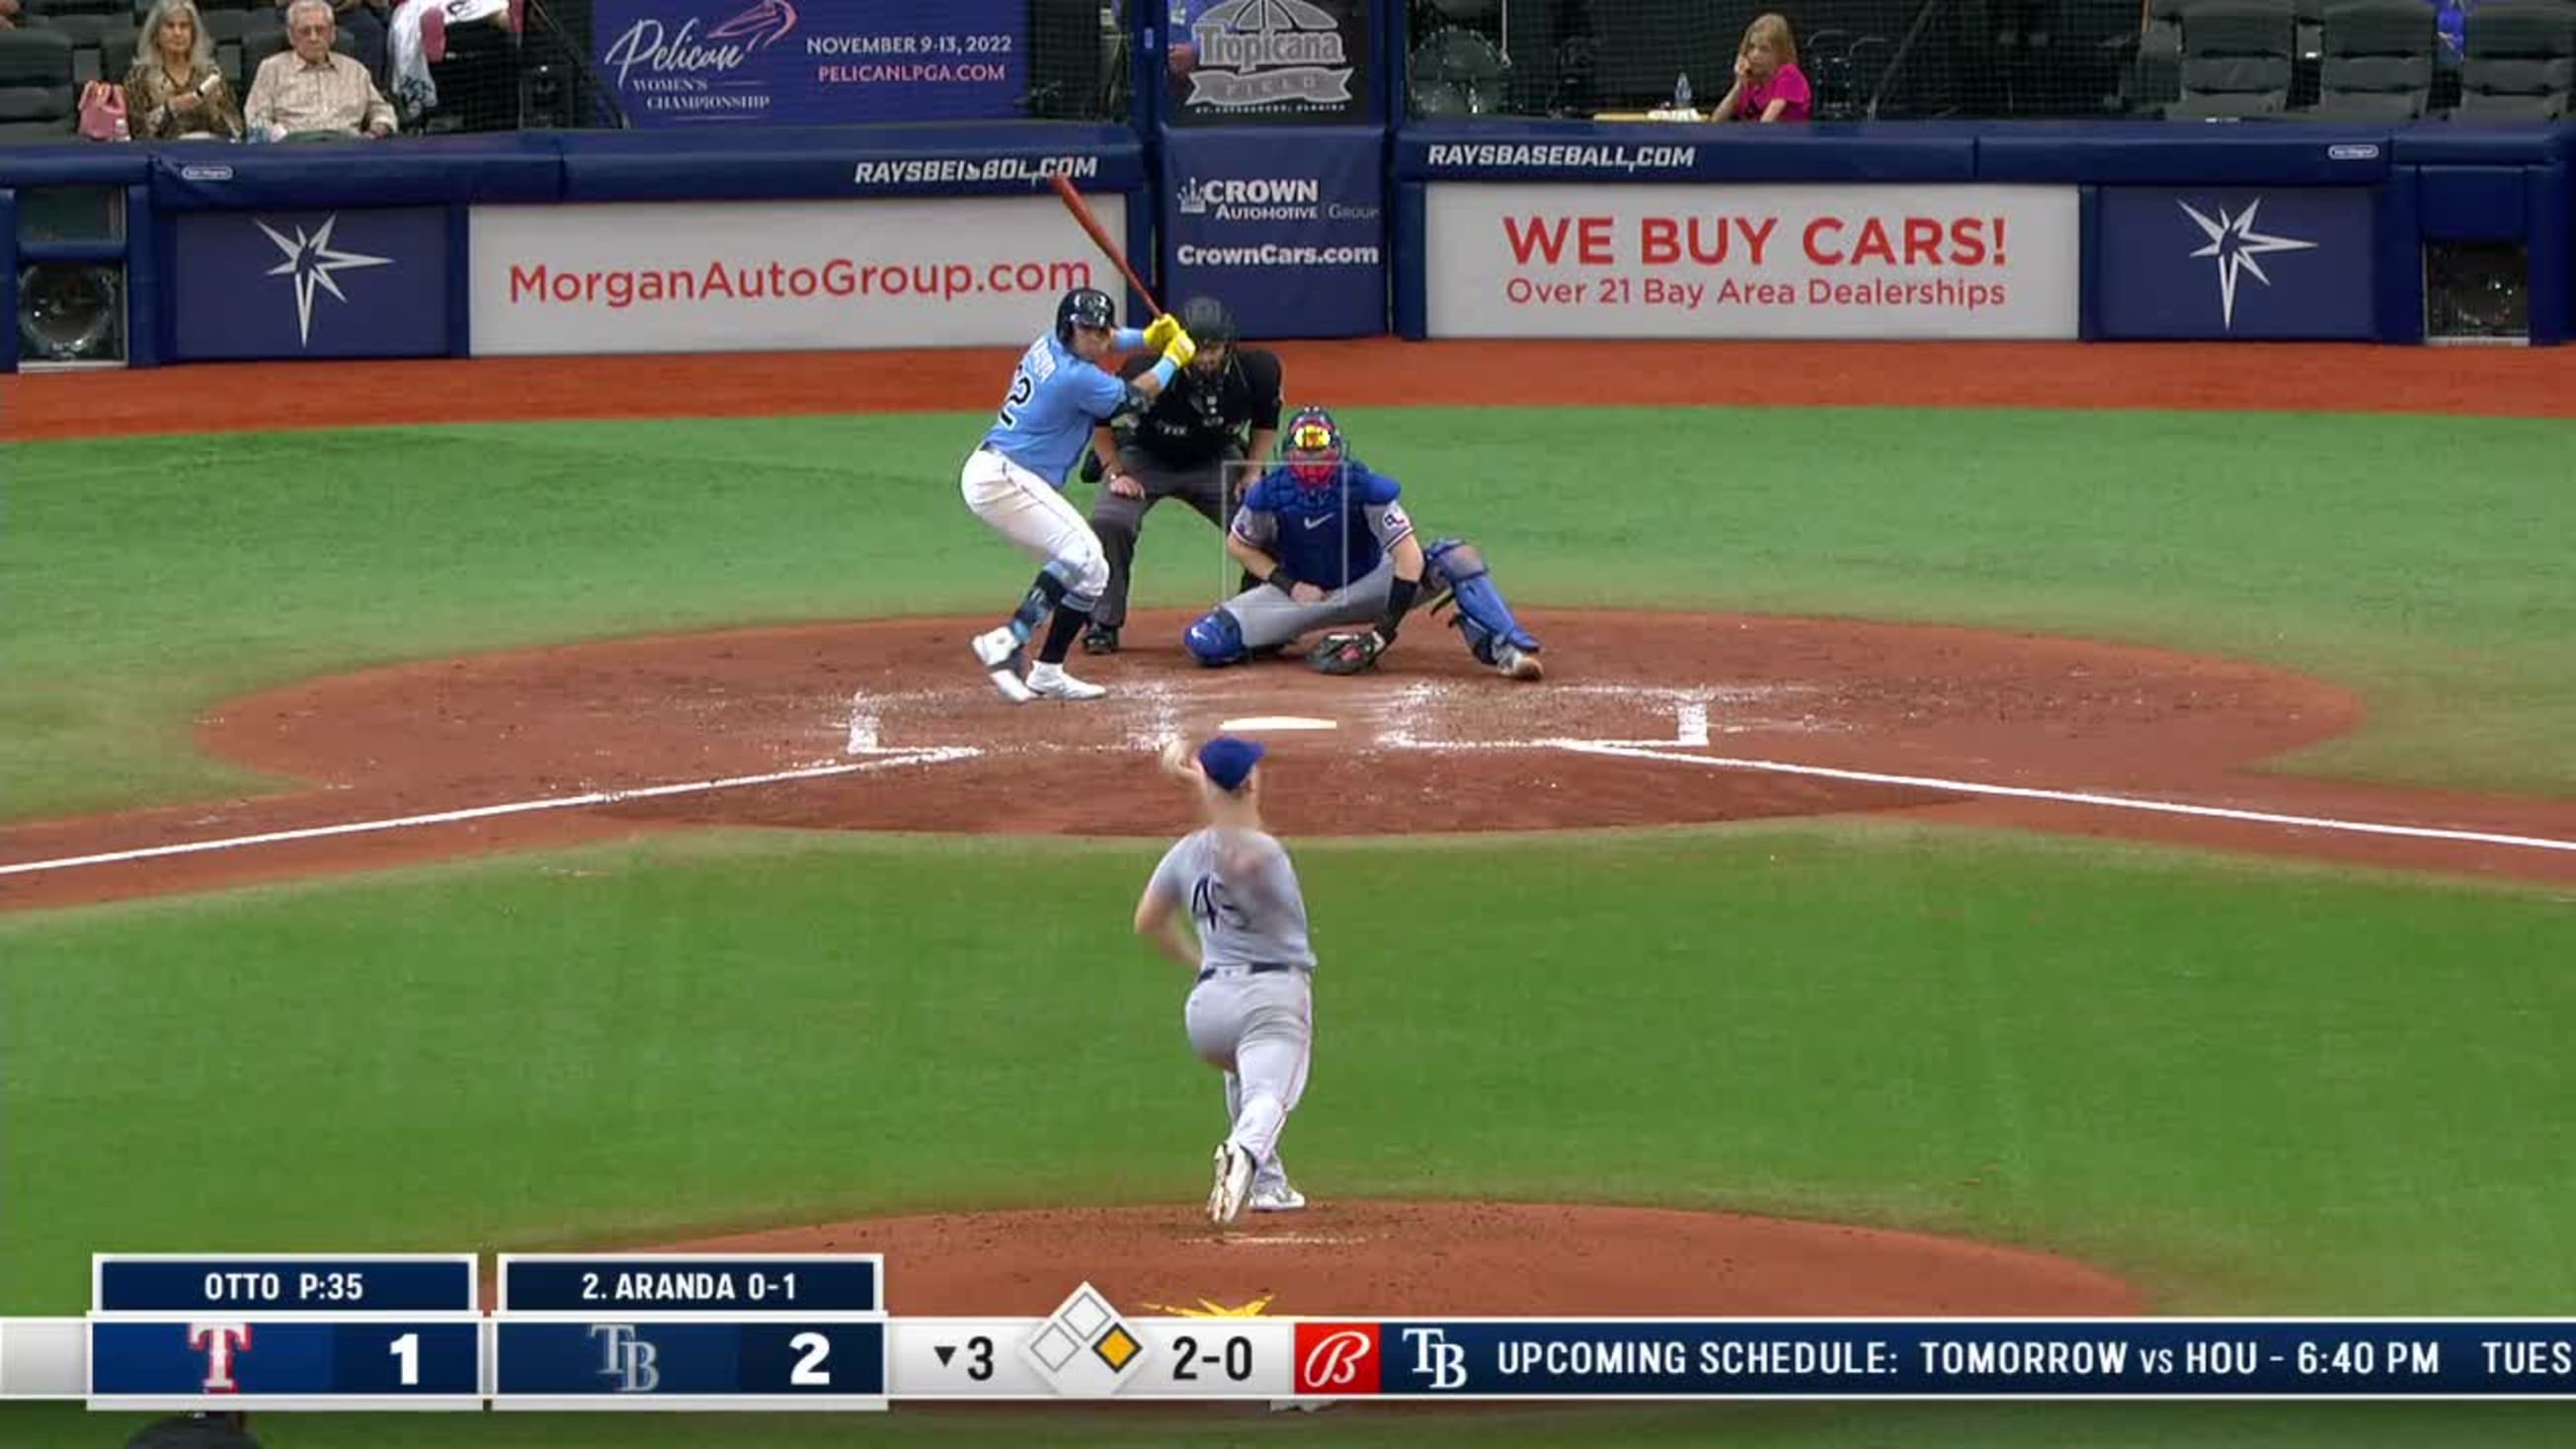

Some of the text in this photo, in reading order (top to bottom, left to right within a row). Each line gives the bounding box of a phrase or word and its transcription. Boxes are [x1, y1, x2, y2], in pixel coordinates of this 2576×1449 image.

[604, 18, 744, 89] Pelican
[806, 36, 1012, 54] NOVEMBER 9-13, 2022
[1192, 24, 1345, 74] Tropicana
[818, 64, 1006, 82] PELICANLPGA.COM
[646, 96, 770, 110] CHAMPIONSHIP
[1204, 179, 1319, 202] CROWN
[1177, 244, 1380, 265] CrownCars.com
[1502, 216, 2007, 267] WE BUY CARS!
[509, 259, 1091, 308] MorganAutoGroup.com
[1506, 278, 2006, 310] Over 21 Bay Area Dealerships
